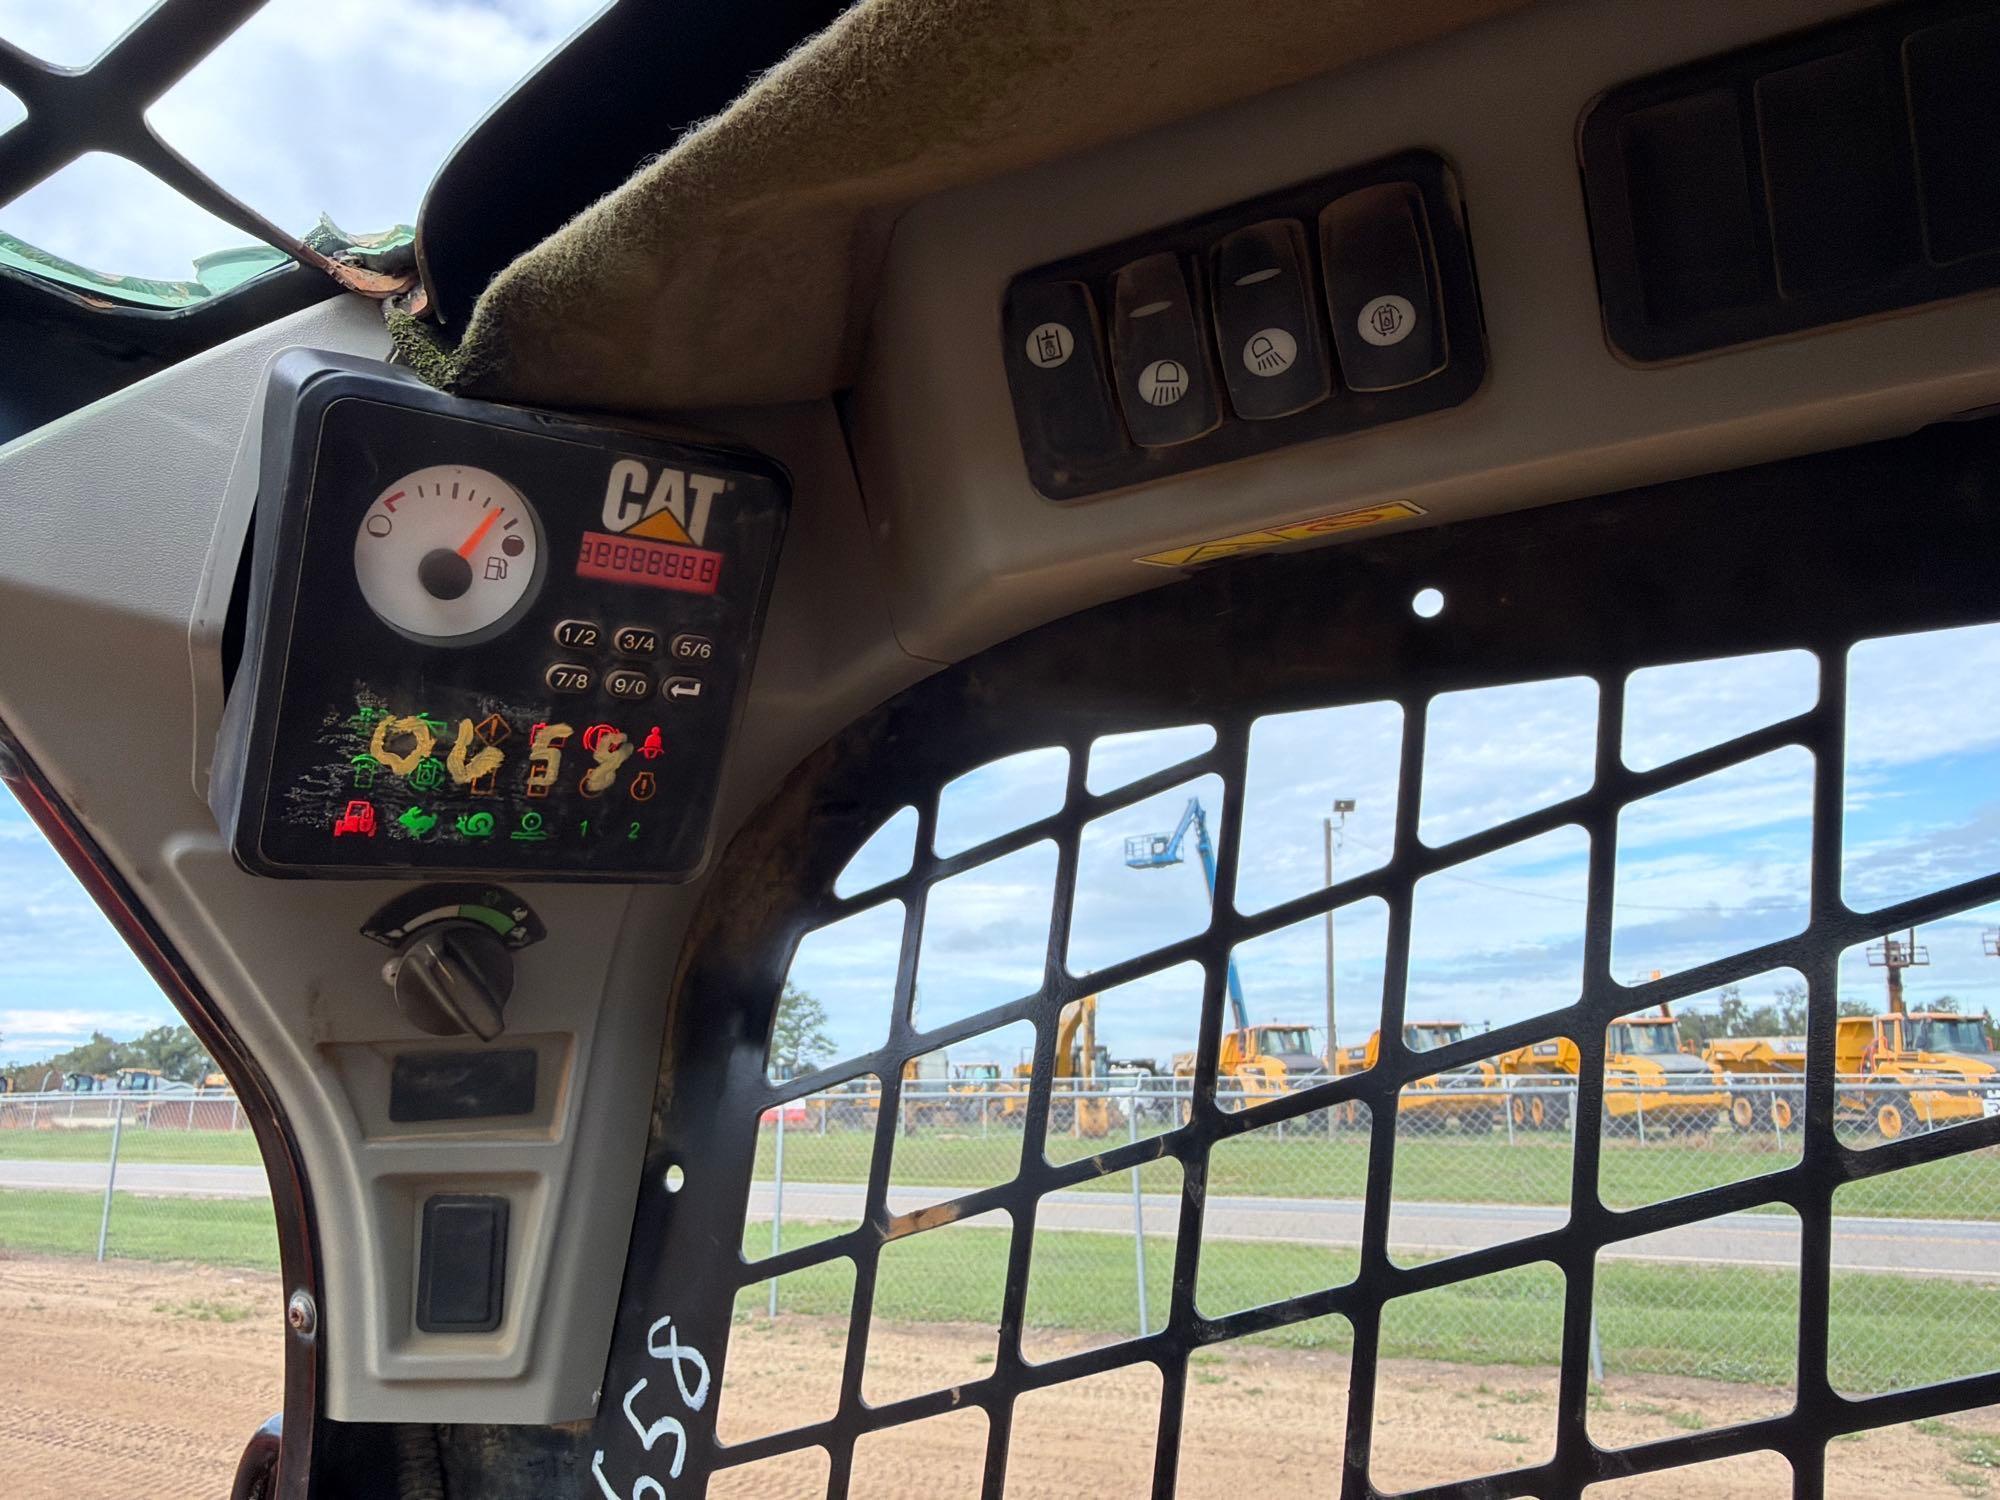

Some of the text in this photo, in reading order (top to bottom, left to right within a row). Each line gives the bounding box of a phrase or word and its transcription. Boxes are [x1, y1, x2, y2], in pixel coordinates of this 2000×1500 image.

[602, 459, 725, 547] CAT
[560, 627, 597, 646] 1/2
[624, 634, 655, 651] 3/4
[680, 641, 712, 659] 5/6
[555, 671, 588, 689] 7/8
[614, 678, 647, 695] 9/0
[628, 822, 640, 839] 2
